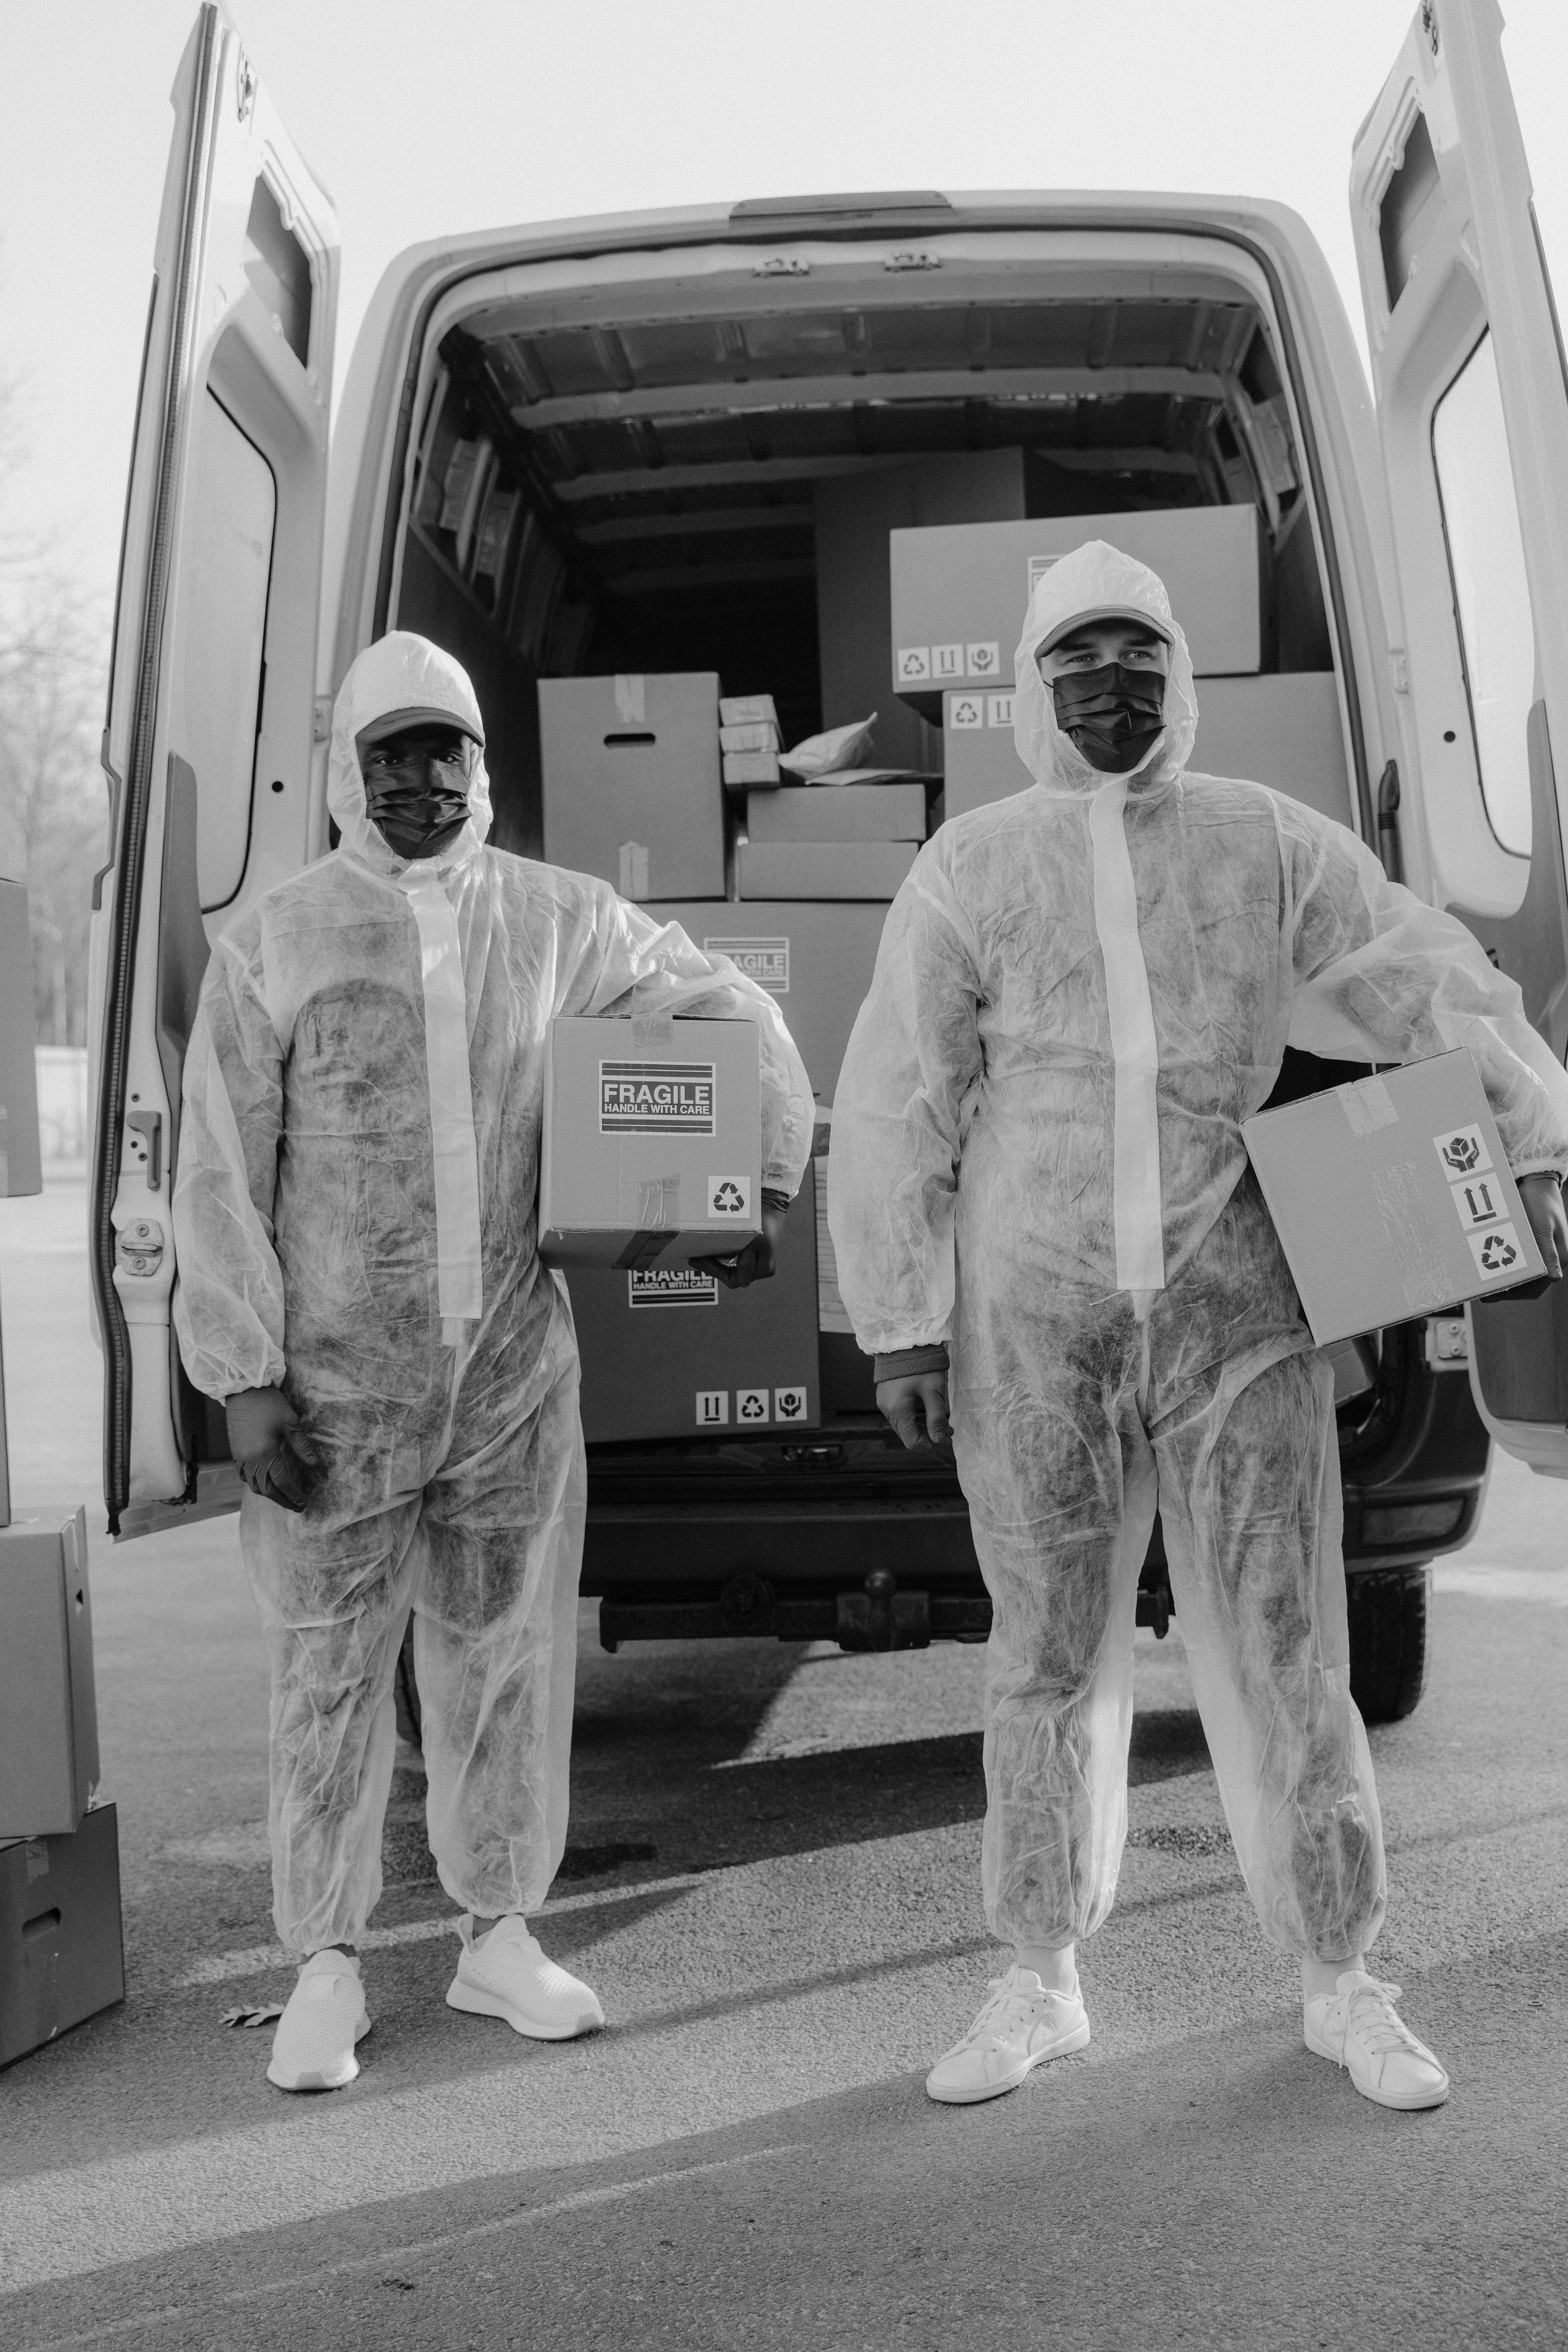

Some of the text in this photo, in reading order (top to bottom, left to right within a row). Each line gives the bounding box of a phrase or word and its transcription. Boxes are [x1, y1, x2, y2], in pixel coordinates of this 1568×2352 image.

[731, 954, 784, 970] AGILE
[604, 1084, 710, 1104] FRAGILE
[604, 1103, 710, 1114] HANDLE WITH CARE
